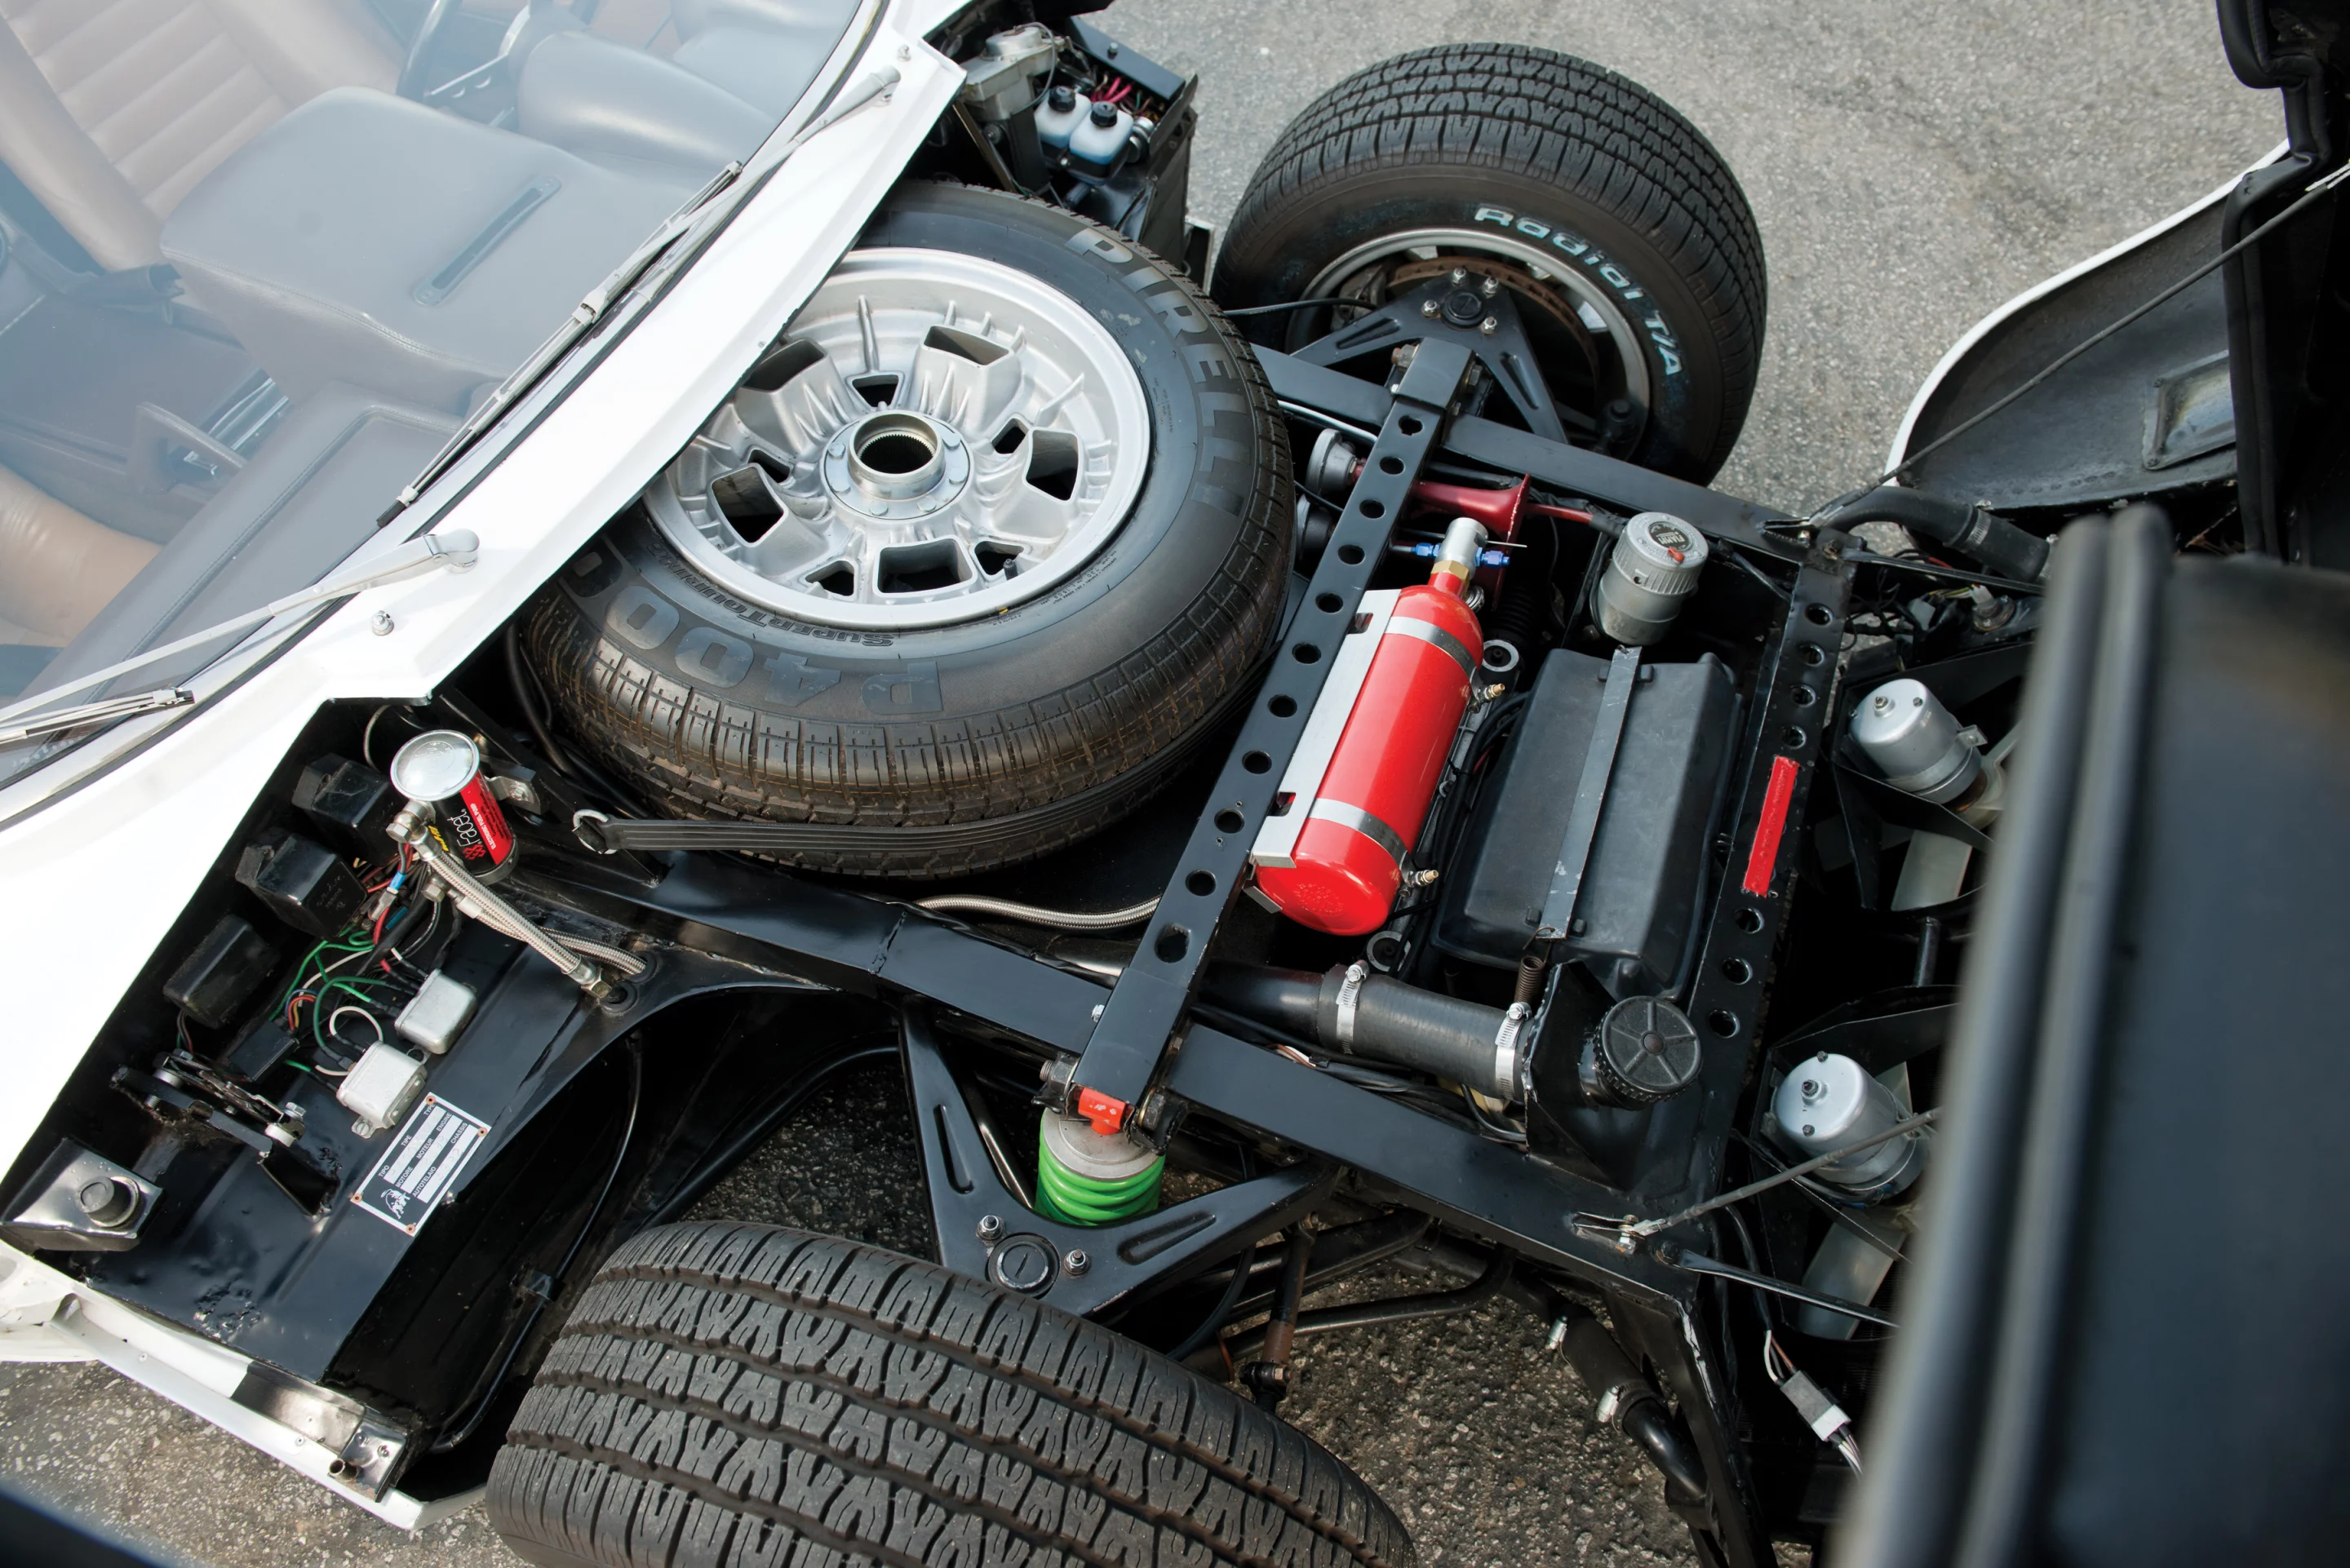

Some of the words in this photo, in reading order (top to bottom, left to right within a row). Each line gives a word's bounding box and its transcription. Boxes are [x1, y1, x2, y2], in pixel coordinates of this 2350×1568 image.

[1474, 207, 1644, 300] Radial
[1645, 310, 1683, 375] T/A
[1065, 227, 1251, 517] PIRELLI
[447, 811, 481, 847] Facet
[378, 1164, 390, 1178] TIPO
[401, 1135, 413, 1147] TIPE
[423, 1103, 435, 1116] TYPE
[395, 1166, 414, 1188] MOTORE
[415, 1137, 434, 1160] MOTEUR
[436, 1111, 453, 1132] ENGINE
[412, 1166, 437, 1198] AUTOTELAIO
[450, 1122, 468, 1145] CHASSIS
